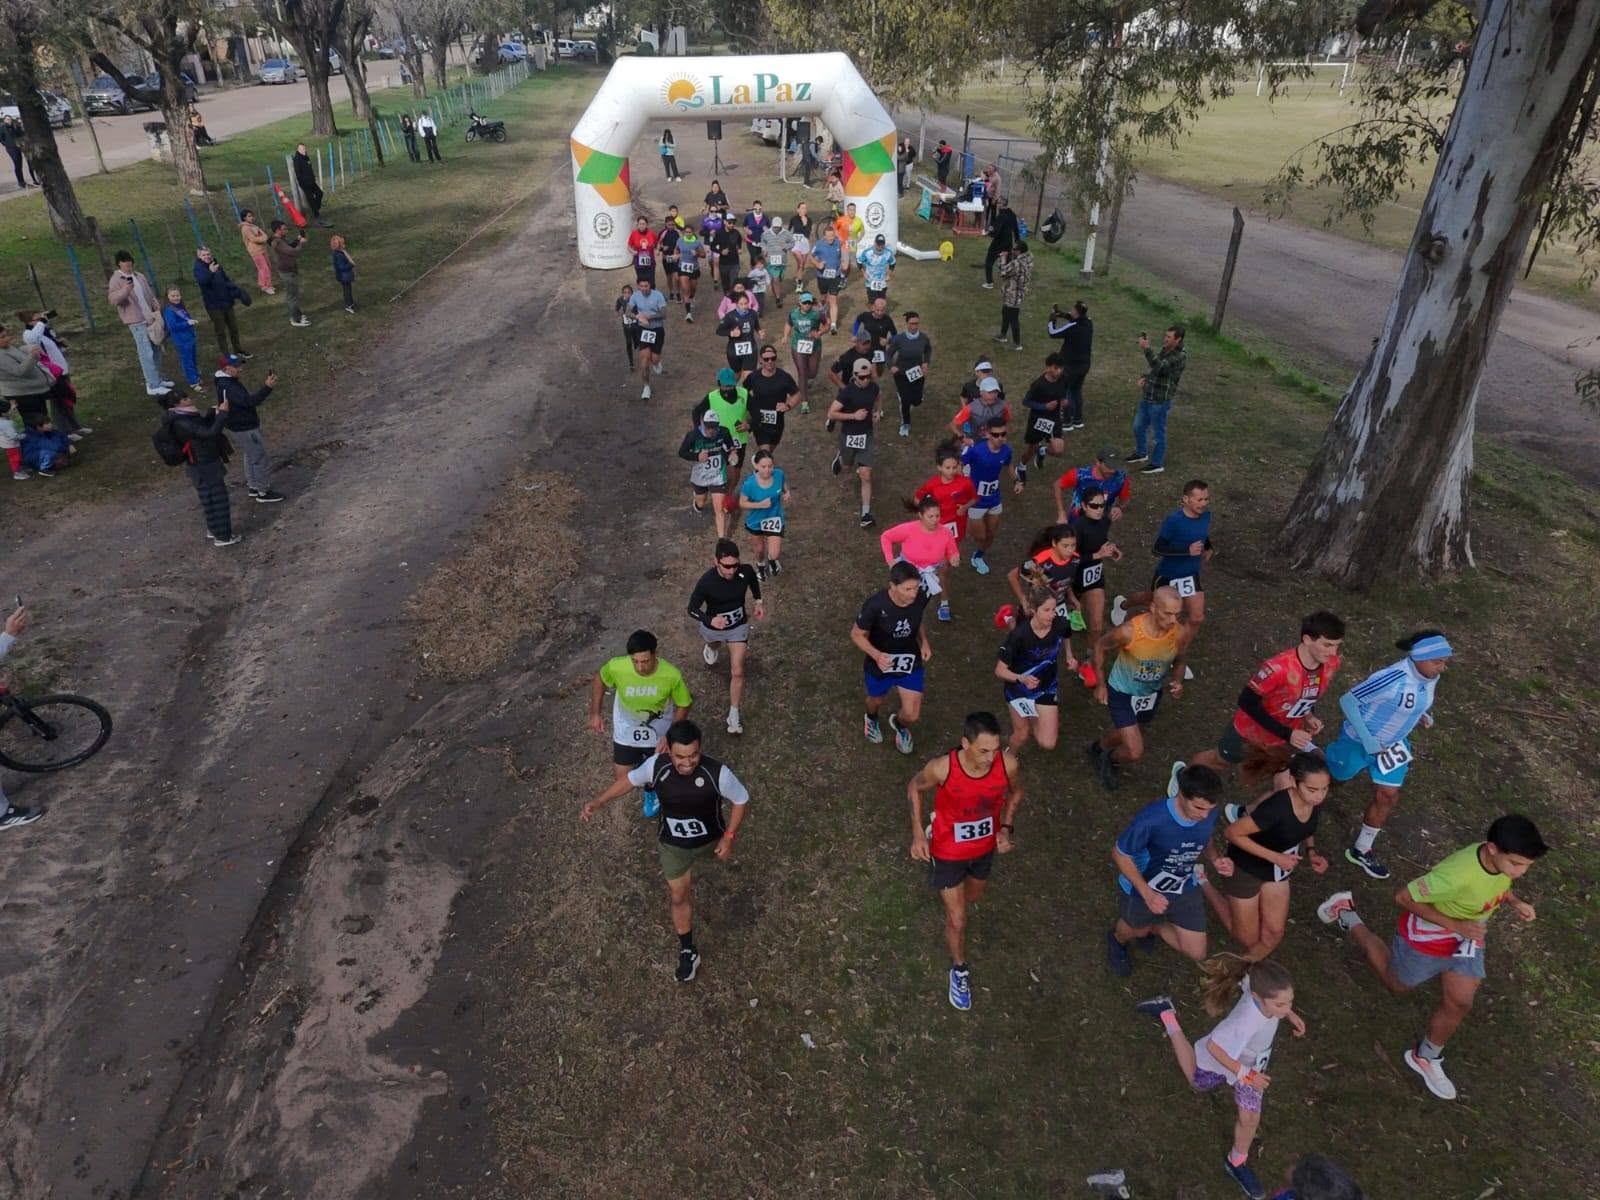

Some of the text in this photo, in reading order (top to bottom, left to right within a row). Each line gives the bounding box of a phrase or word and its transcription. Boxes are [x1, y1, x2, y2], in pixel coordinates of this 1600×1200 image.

[709, 73, 812, 105] La Paz
[682, 263, 693, 273] 44
[643, 331, 656, 343] 42
[737, 343, 750, 354] 27
[799, 342, 812, 353] 72
[908, 368, 923, 382] 221
[849, 436, 865, 448] 248
[704, 457, 720, 471] 30
[762, 519, 782, 531] 224
[1085, 566, 1101, 584] 08
[625, 686, 658, 697] RUN
[1134, 698, 1150, 711] 85
[1399, 692, 1415, 709] 18
[633, 730, 650, 742] 63
[1381, 741, 1408, 771] 05
[674, 821, 702, 837] 49
[960, 820, 991, 840] 38
